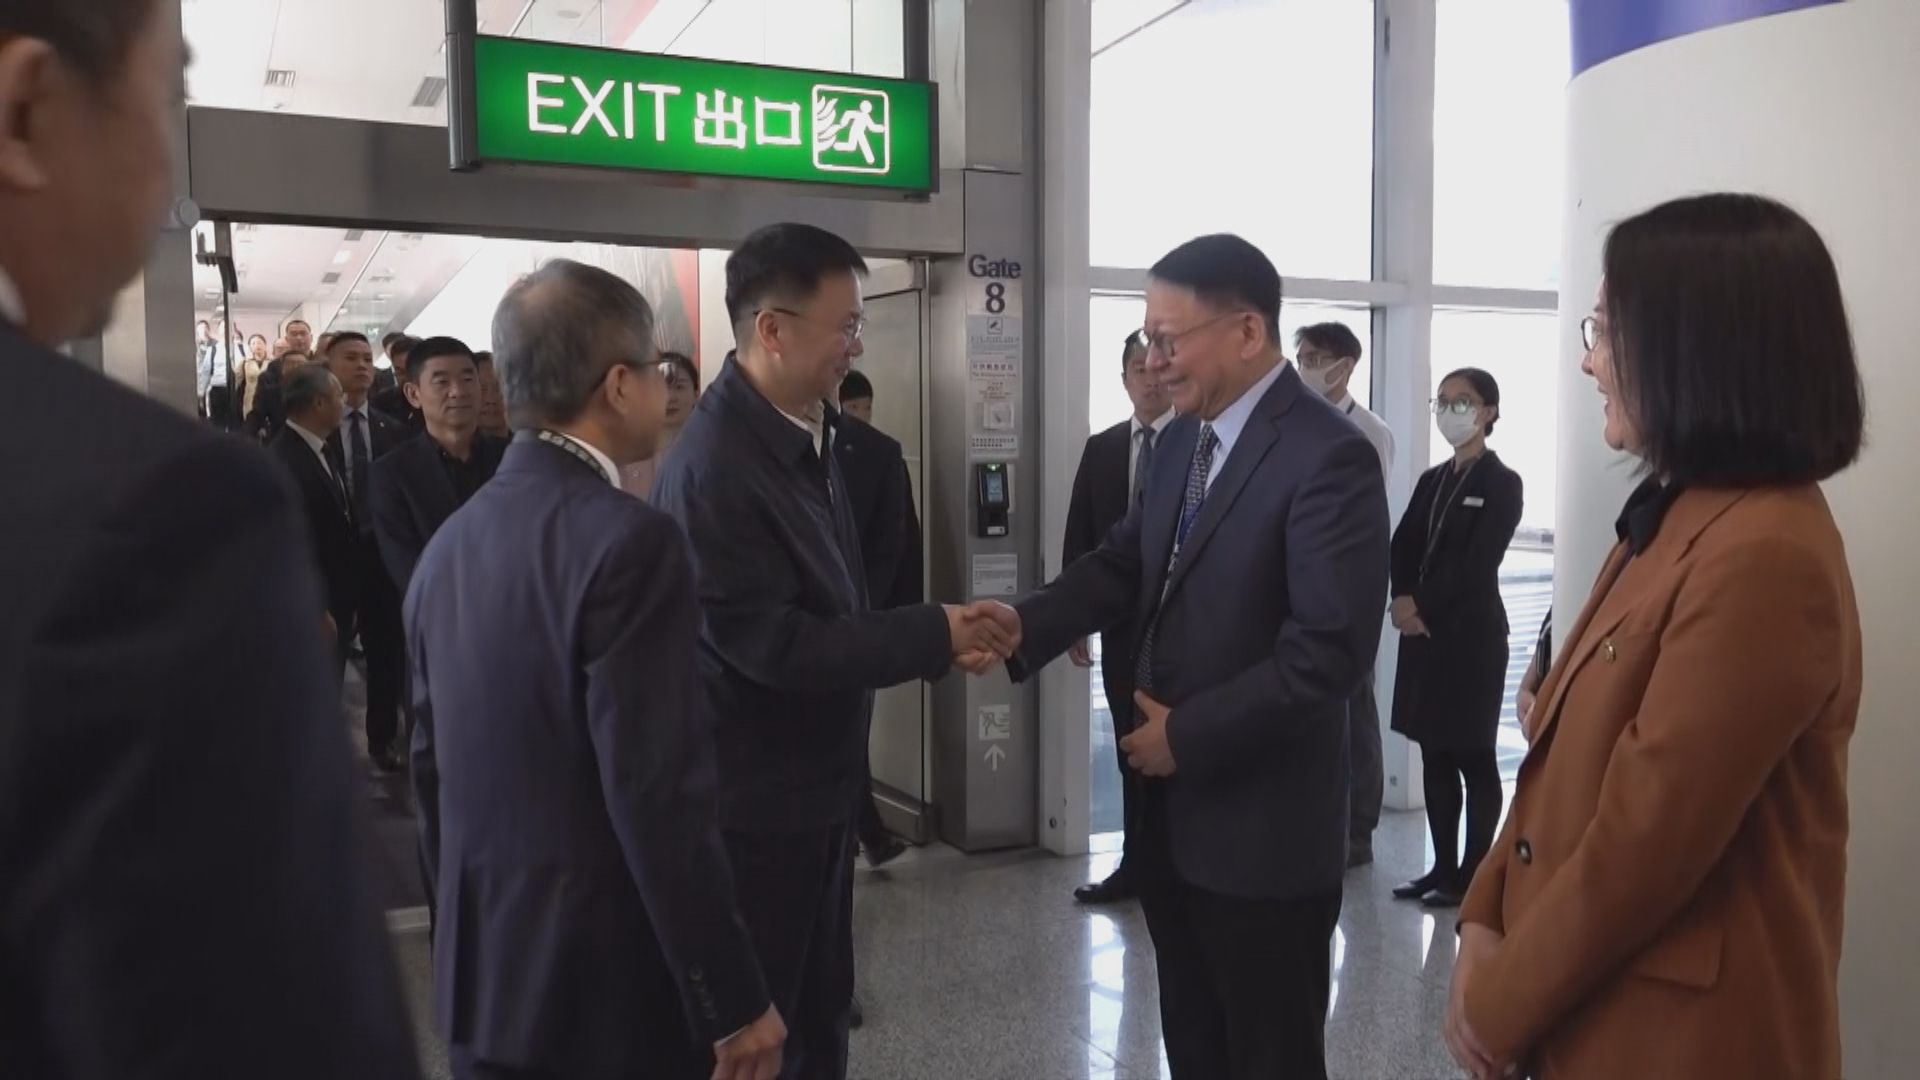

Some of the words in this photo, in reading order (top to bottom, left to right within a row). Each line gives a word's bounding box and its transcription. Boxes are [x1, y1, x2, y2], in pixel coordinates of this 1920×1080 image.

[527, 72, 681, 141] EXIT
[694, 89, 802, 149] 出口
[968, 254, 1021, 279] Gate
[985, 282, 1006, 314] 8
